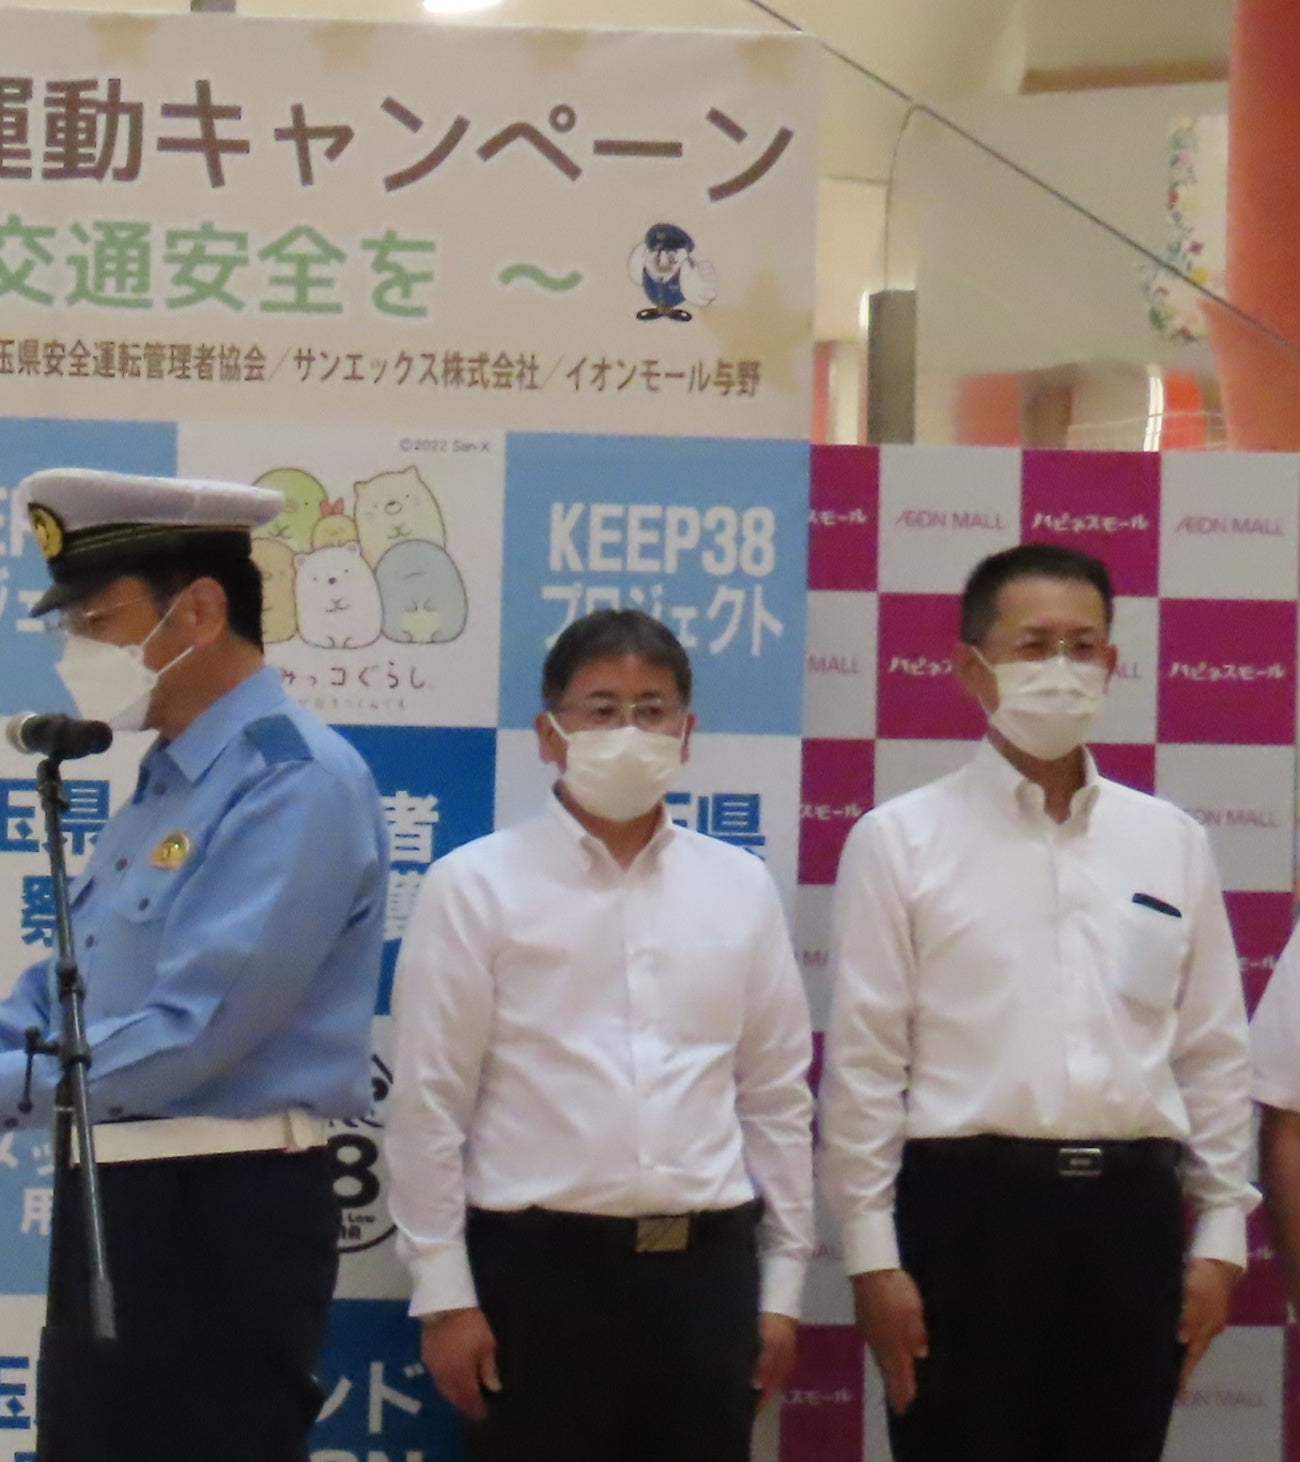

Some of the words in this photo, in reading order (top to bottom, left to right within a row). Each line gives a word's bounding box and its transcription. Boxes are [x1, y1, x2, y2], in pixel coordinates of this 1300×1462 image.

[808, 507, 868, 526] スモール
[953, 511, 1006, 531] MALL
[1233, 516, 1285, 536] MALL
[549, 502, 777, 577] KEEP38
[281, 660, 425, 689] っコぐらし
[888, 657, 953, 677] ハピネス
[800, 802, 862, 820] スモール
